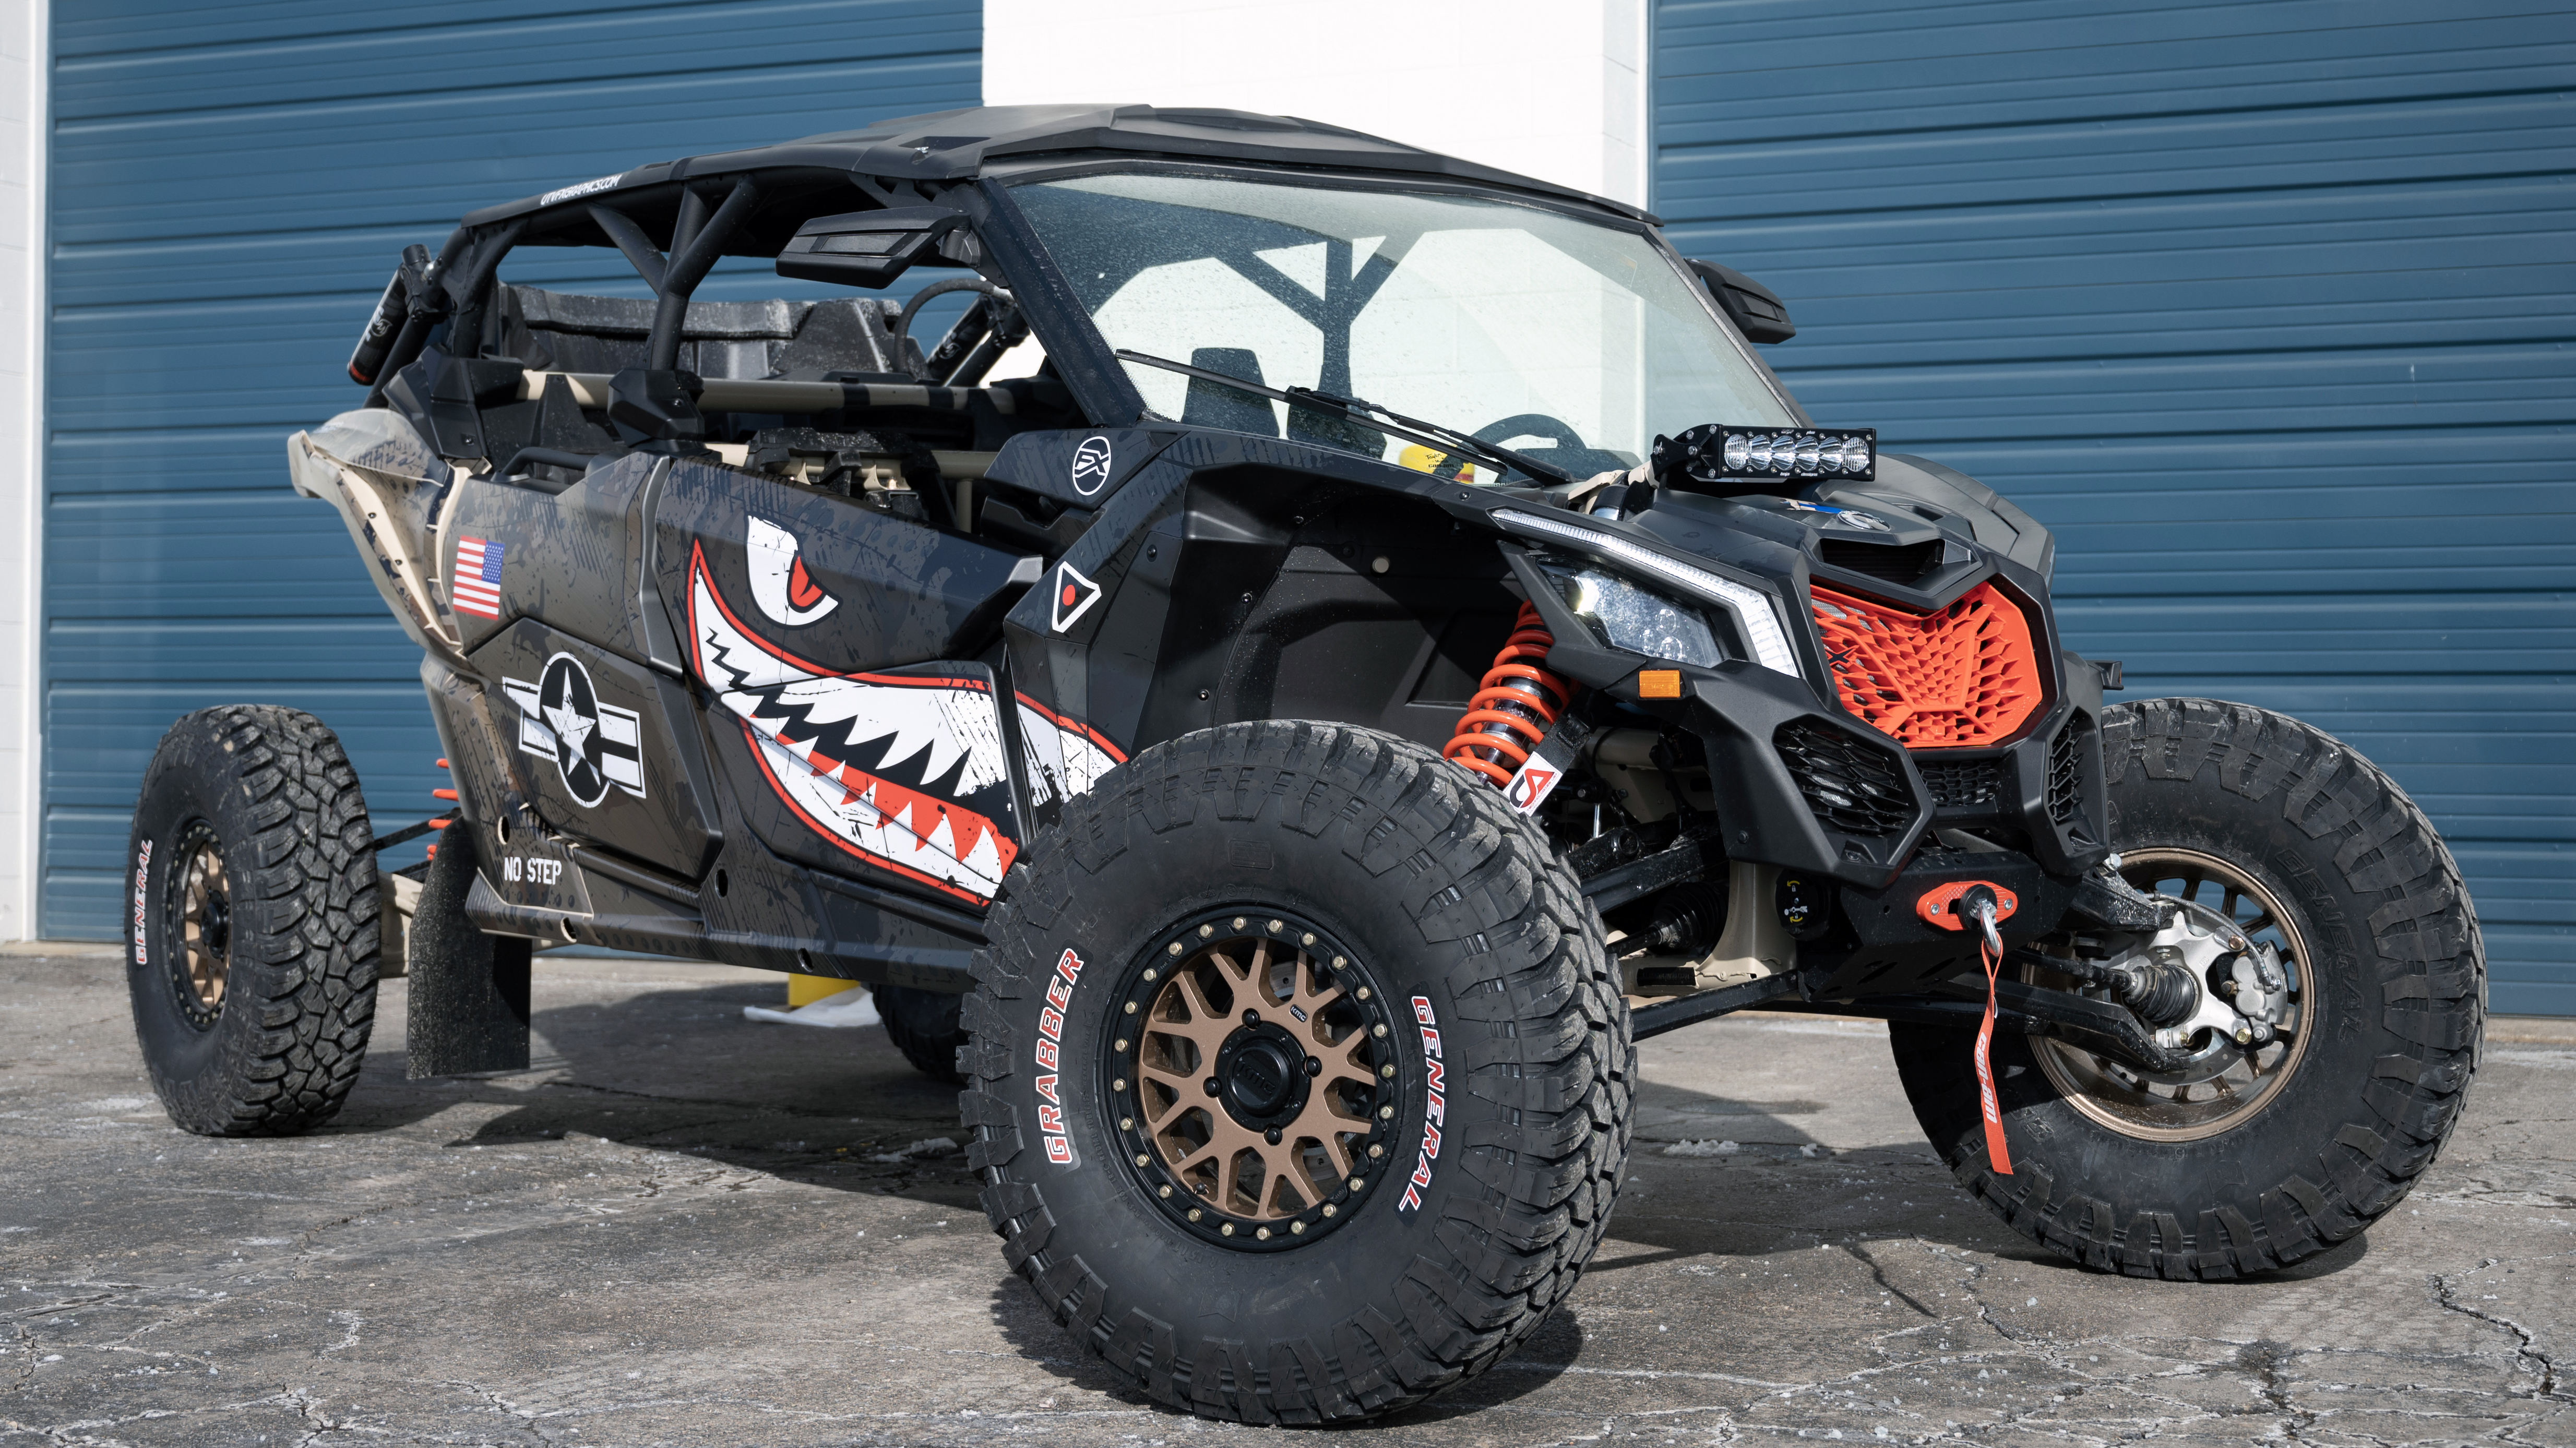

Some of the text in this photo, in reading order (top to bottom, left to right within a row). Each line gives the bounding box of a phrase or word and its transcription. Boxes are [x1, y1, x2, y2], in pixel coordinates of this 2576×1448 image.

[540, 174, 622, 206] UTVFXGRAPHICS.COM
[504, 857, 563, 885] NO STEP
[134, 839, 154, 965] GENERAL
[1291, 1006, 1306, 1022] KMC
[1036, 947, 1084, 1165] GRABBER
[1975, 1032, 1998, 1123] can-am
[1399, 995, 1446, 1212] GENERAL
[1090, 1132, 1106, 1162] RADIAL
